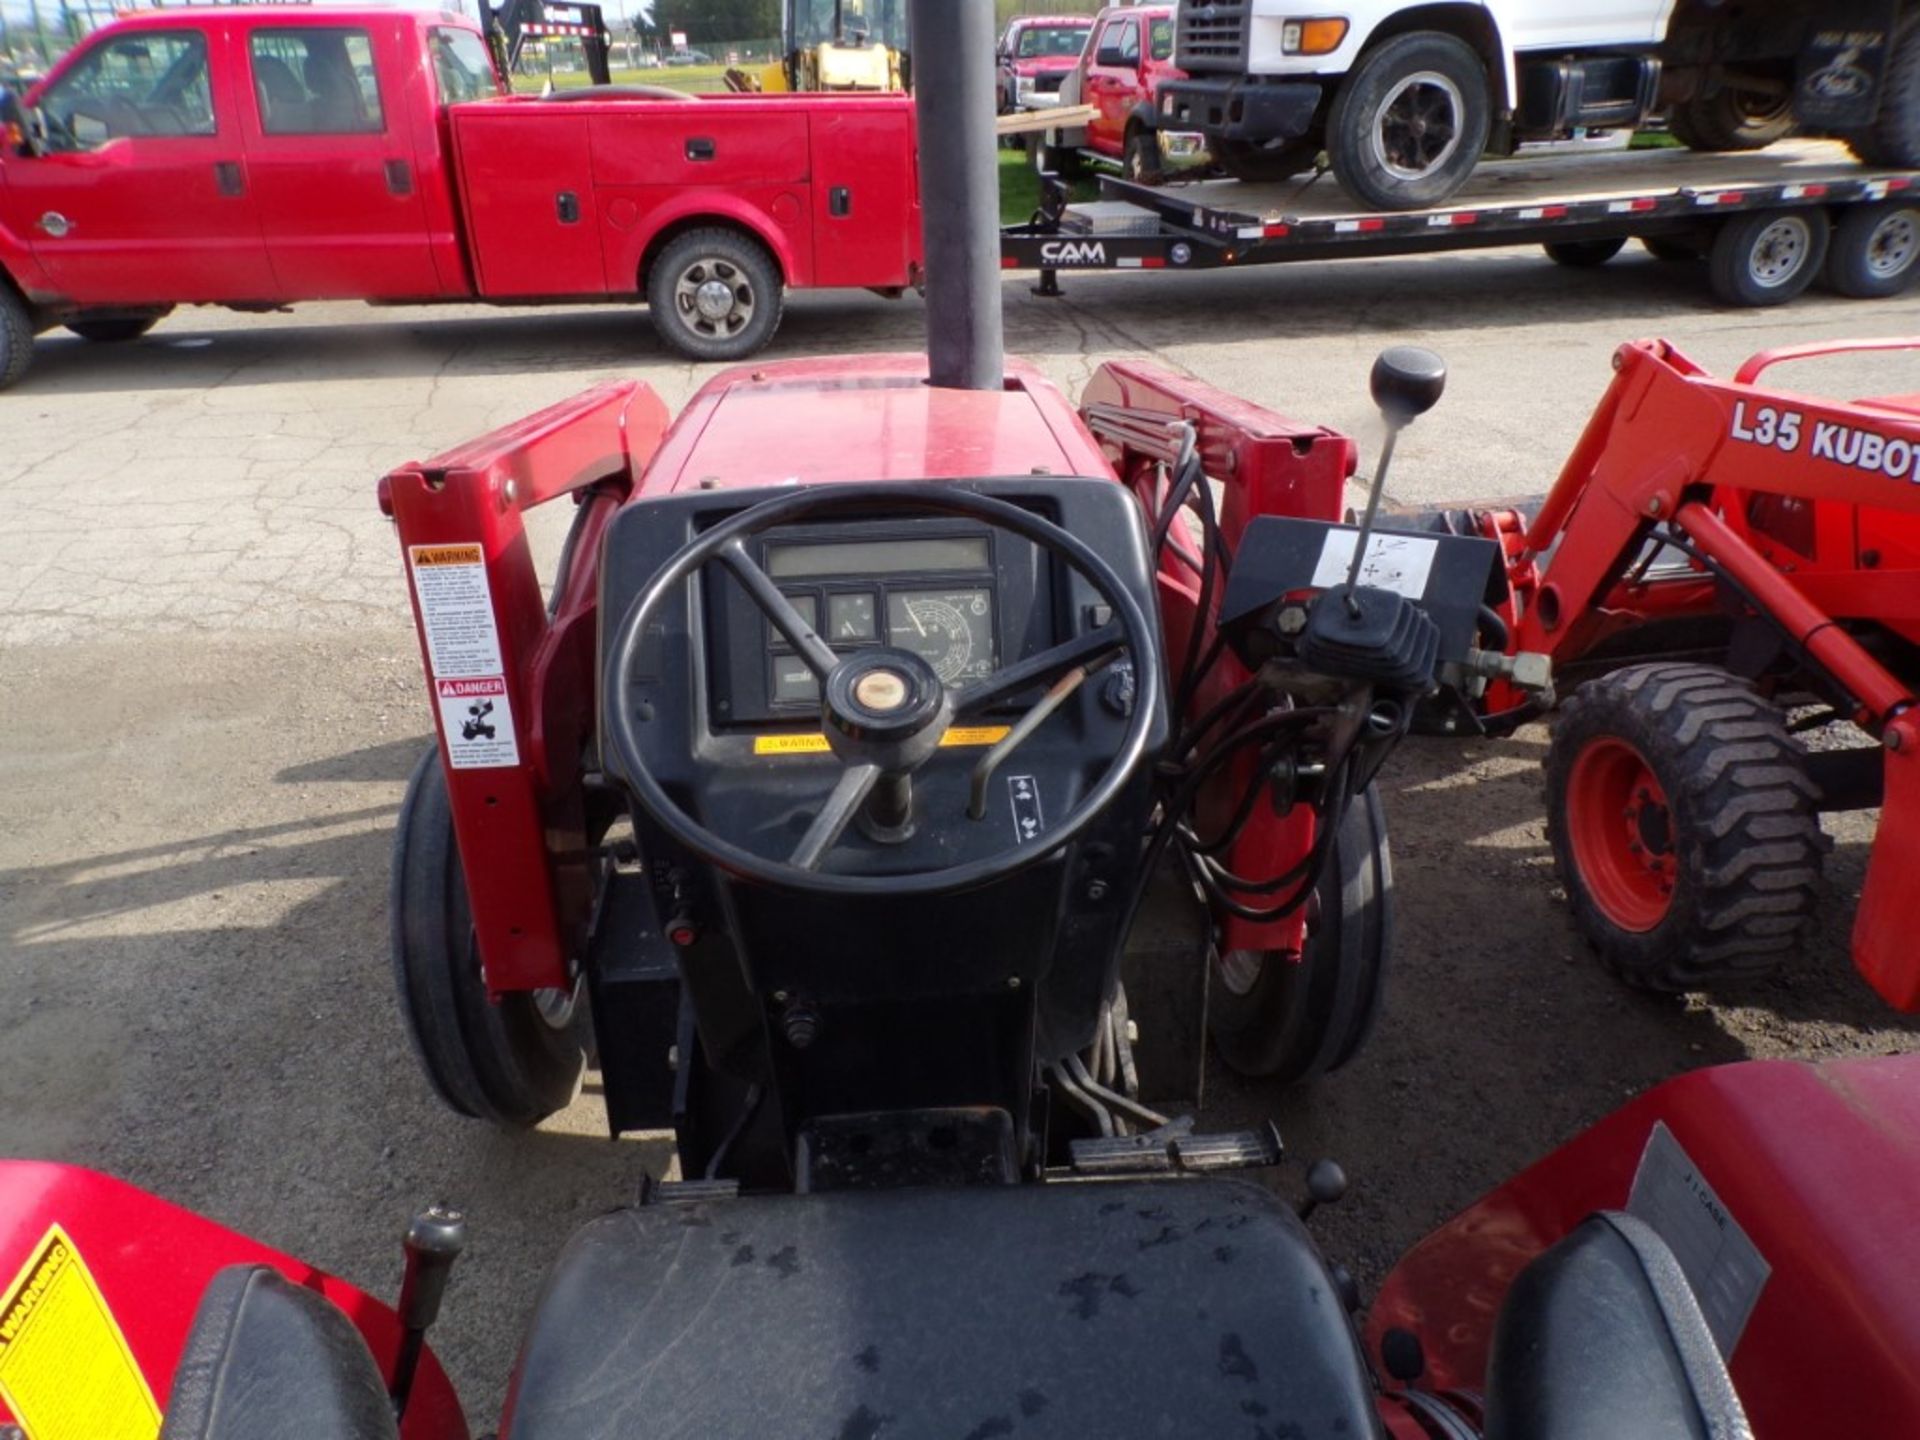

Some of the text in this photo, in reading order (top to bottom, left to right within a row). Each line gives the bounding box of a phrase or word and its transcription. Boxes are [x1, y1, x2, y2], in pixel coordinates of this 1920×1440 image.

[1041, 242, 1106, 264] CAM
[1731, 401, 1802, 451] L35
[455, 680, 503, 694] DANGER
[0, 1244, 68, 1339] WARNING
